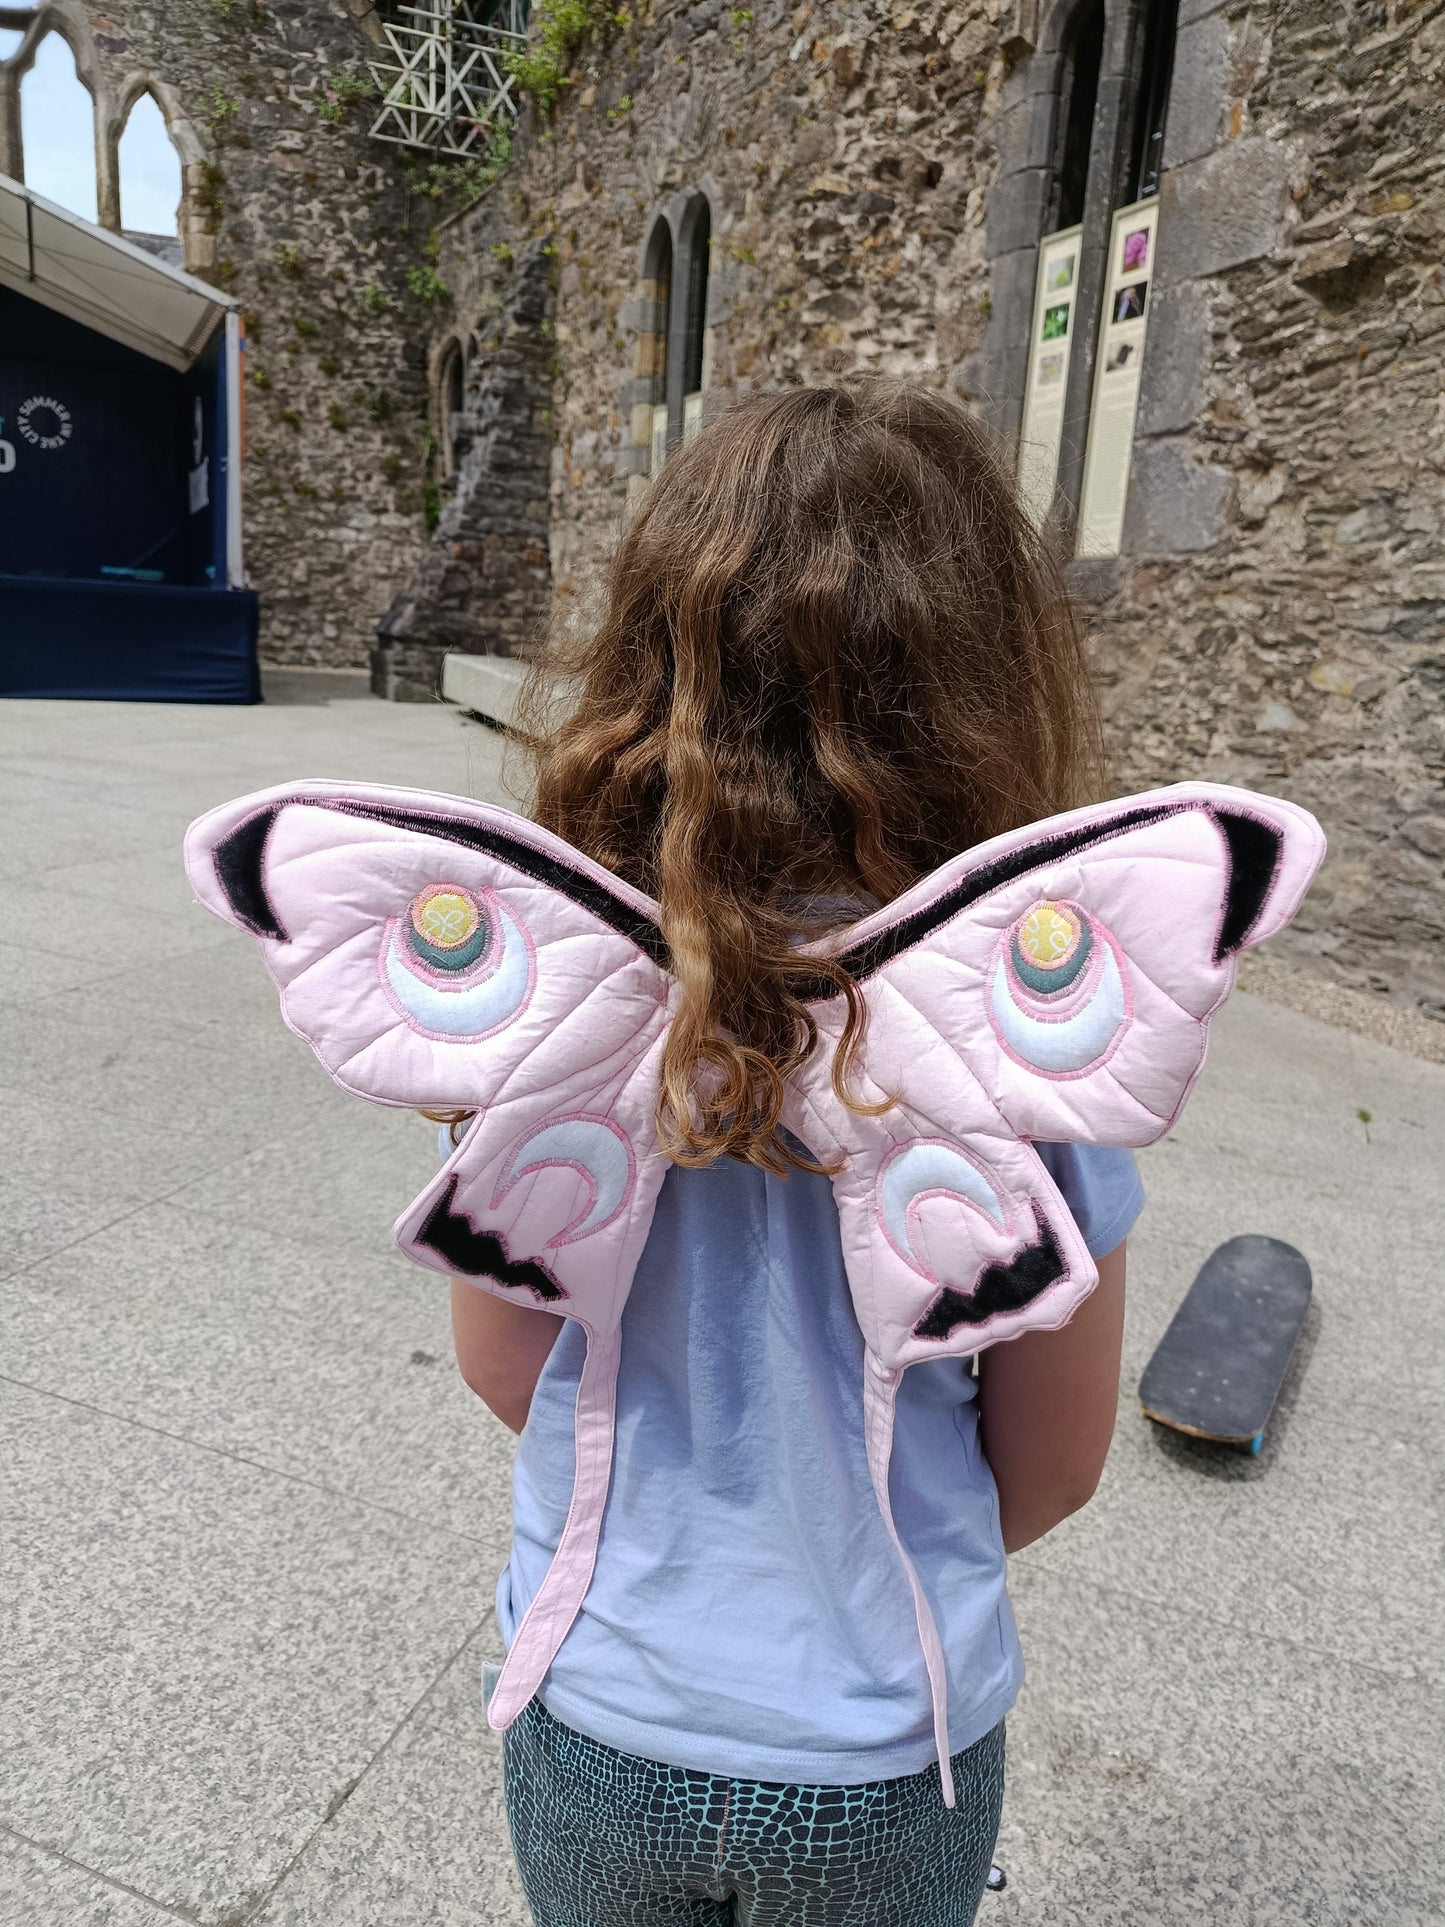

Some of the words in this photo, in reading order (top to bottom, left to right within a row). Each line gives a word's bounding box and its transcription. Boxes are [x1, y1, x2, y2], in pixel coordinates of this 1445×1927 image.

[19, 395, 71, 422] SUMMER
[17, 416, 39, 444] CITY
[60, 423, 73, 438] IN
[40, 435, 66, 449] THE
